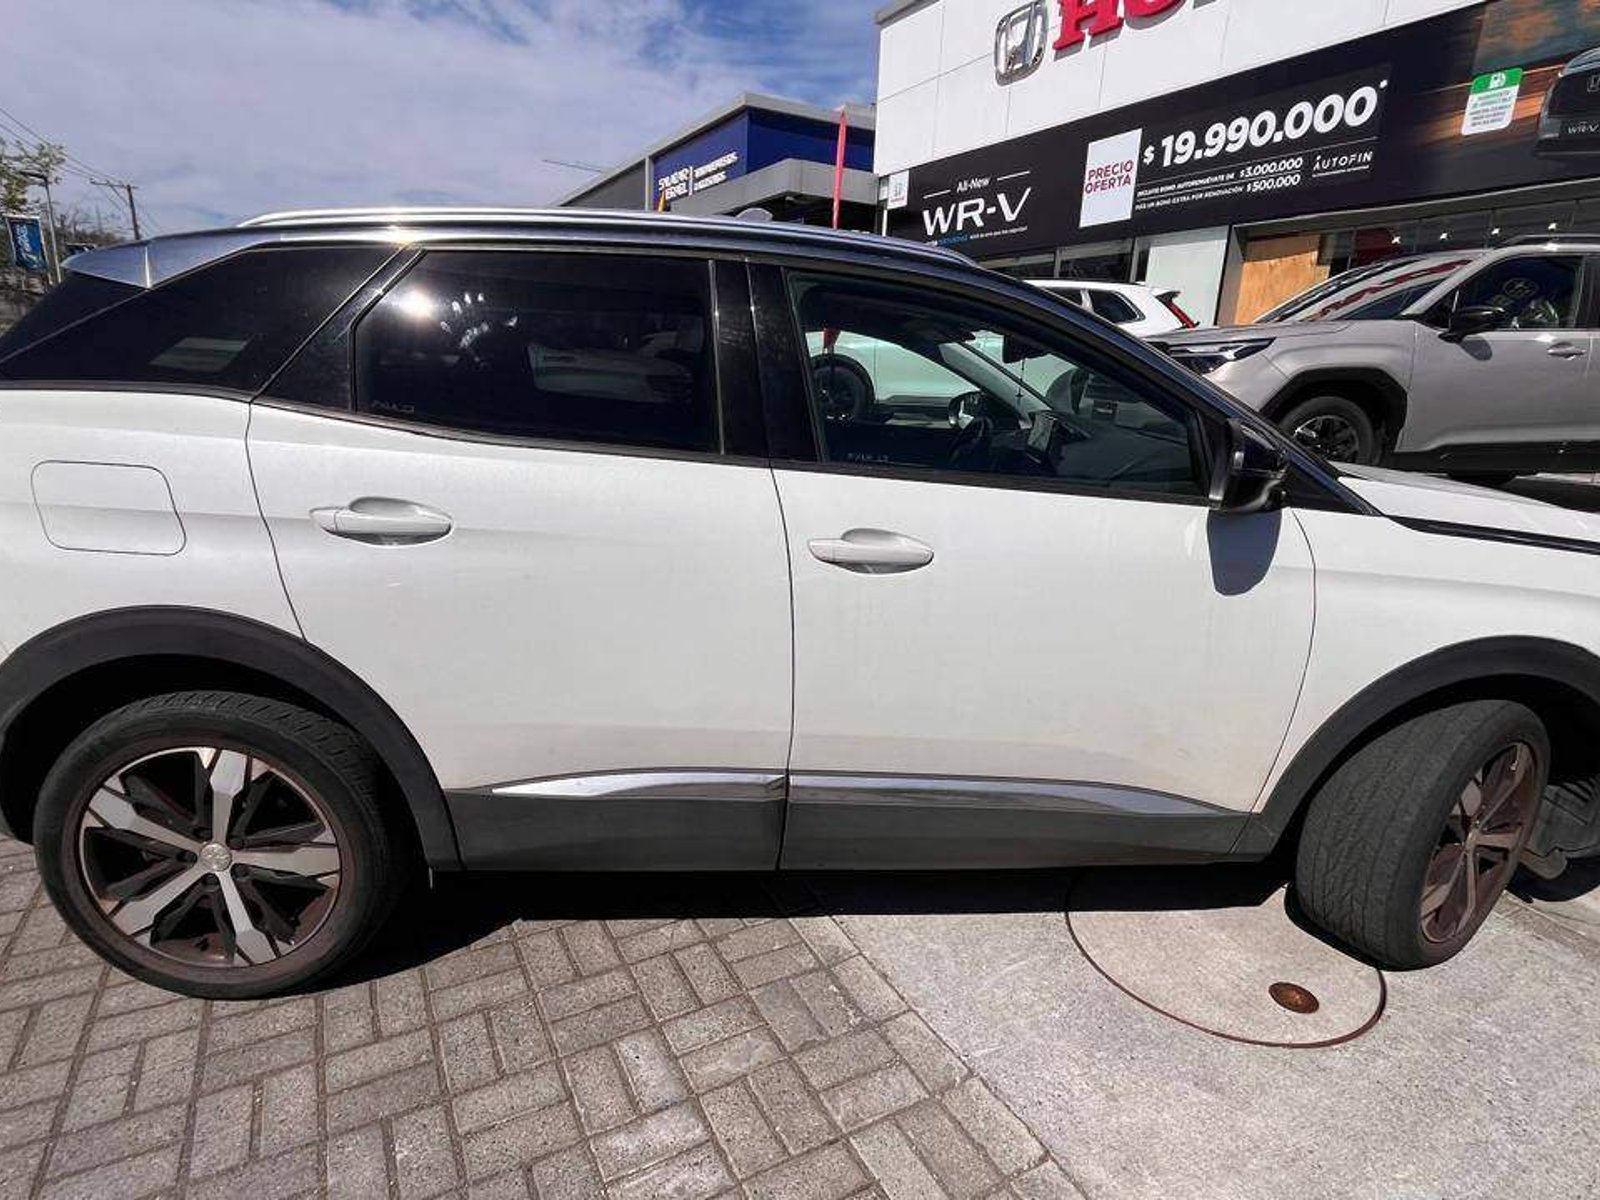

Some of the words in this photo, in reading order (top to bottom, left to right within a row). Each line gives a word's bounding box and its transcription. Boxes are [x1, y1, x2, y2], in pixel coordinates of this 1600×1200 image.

[1088, 160, 1134, 181] PRECIO
[1085, 174, 1131, 194] OFERTA
[1247, 173, 1301, 192] $500.000
[923, 187, 1031, 236] WR-V
